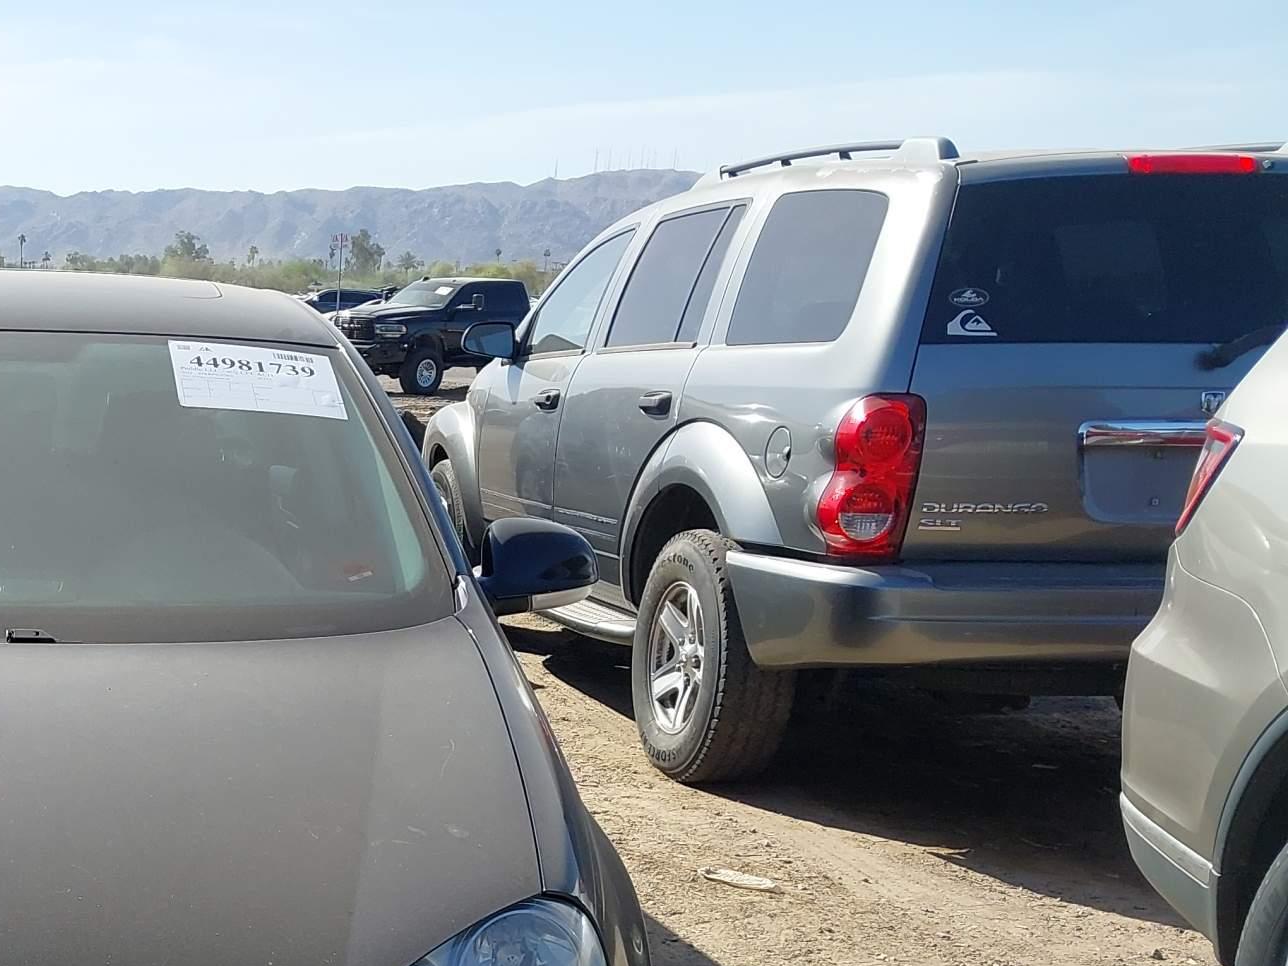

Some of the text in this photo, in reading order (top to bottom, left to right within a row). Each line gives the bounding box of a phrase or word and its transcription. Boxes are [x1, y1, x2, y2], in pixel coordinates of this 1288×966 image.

[189, 354, 316, 378] 44981739
[921, 502, 1049, 513] DURANGO
[919, 518, 962, 526] SLT
